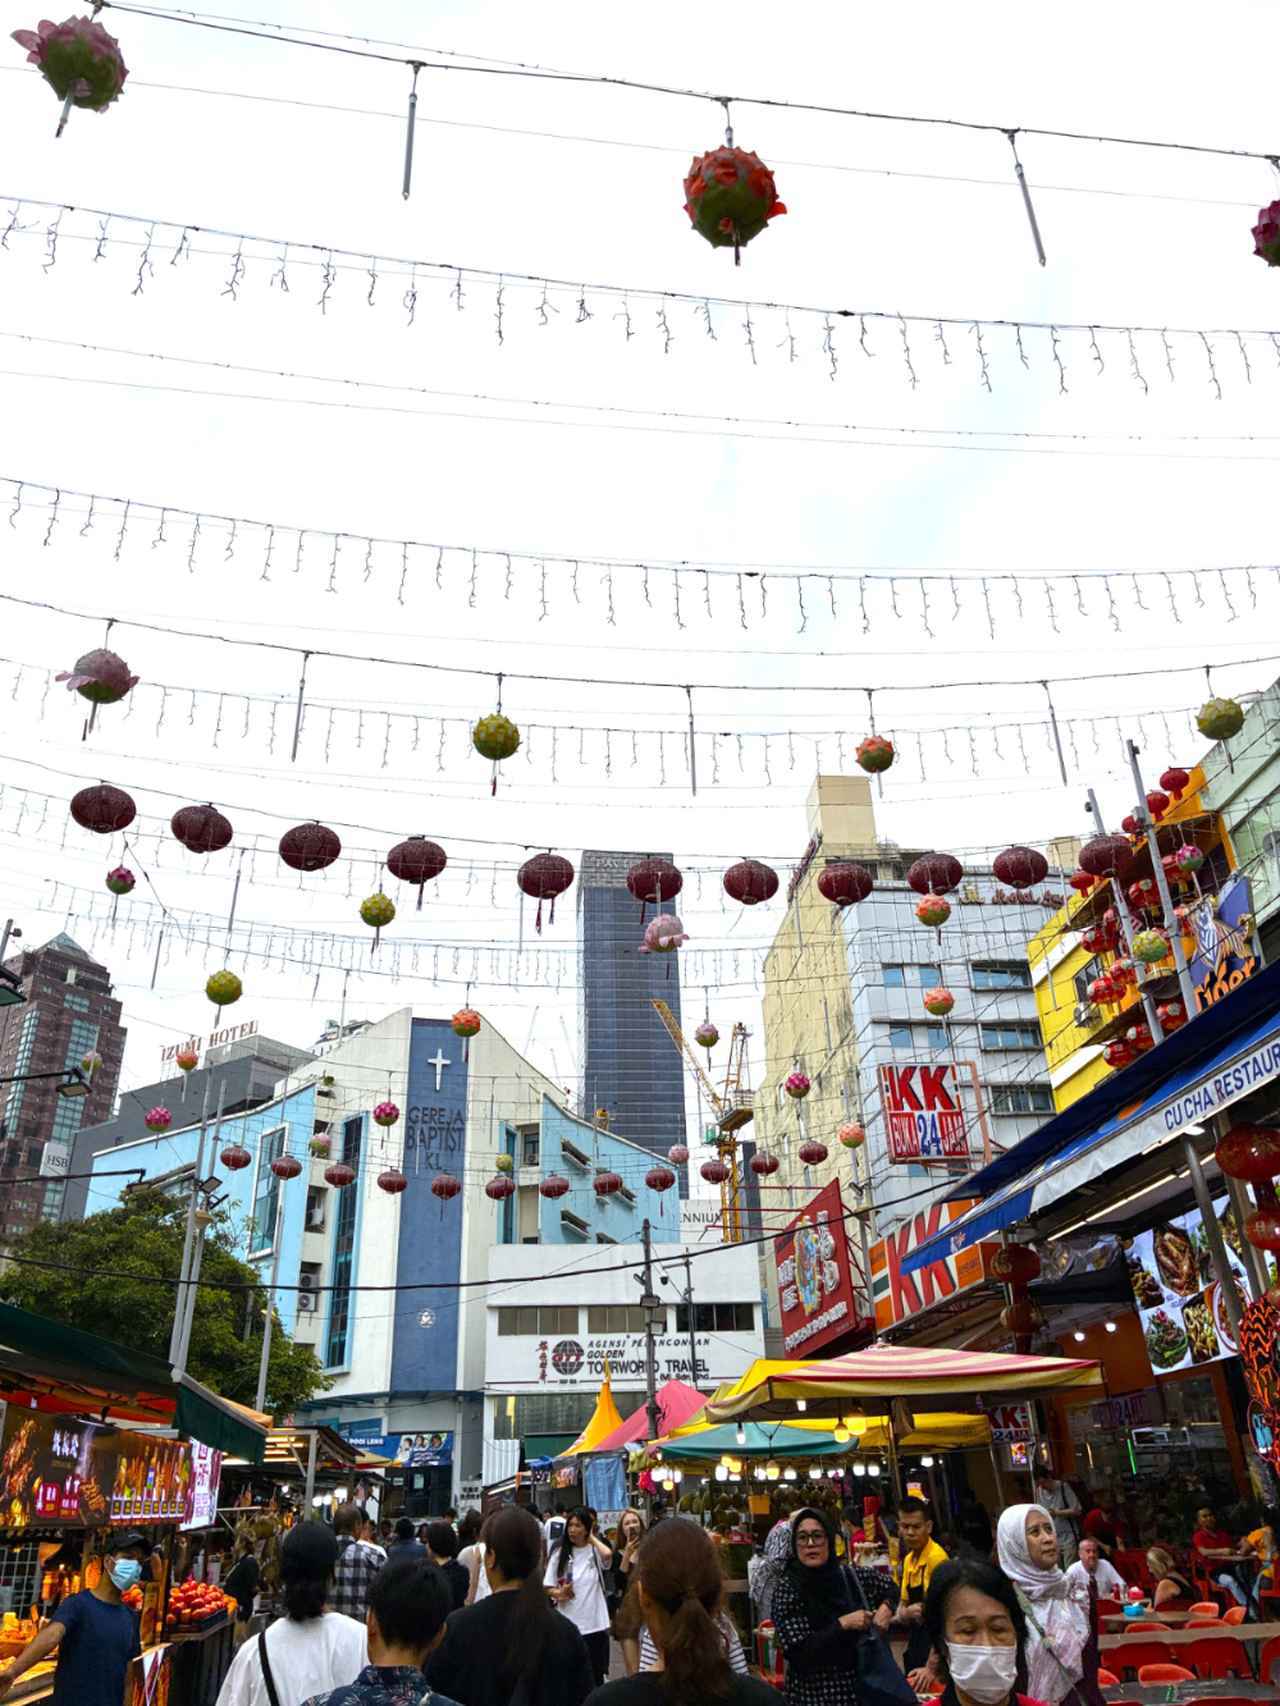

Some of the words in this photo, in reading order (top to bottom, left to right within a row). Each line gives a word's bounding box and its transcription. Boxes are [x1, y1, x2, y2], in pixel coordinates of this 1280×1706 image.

[209, 1020, 259, 1047] HOTEL
[888, 1065, 957, 1111] KK
[408, 1105, 466, 1125] GEREJA
[1164, 1102, 1183, 1131] CU
[1184, 1086, 1215, 1119] CHA
[406, 1125, 465, 1152] BAPTIST
[917, 1113, 942, 1155] 24
[426, 1151, 443, 1169] KL
[887, 1200, 957, 1323] KK
[587, 1338, 626, 1348] AGENSI
[587, 1350, 625, 1359] GOLDEN
[665, 1359, 710, 1373] TRAVEL
